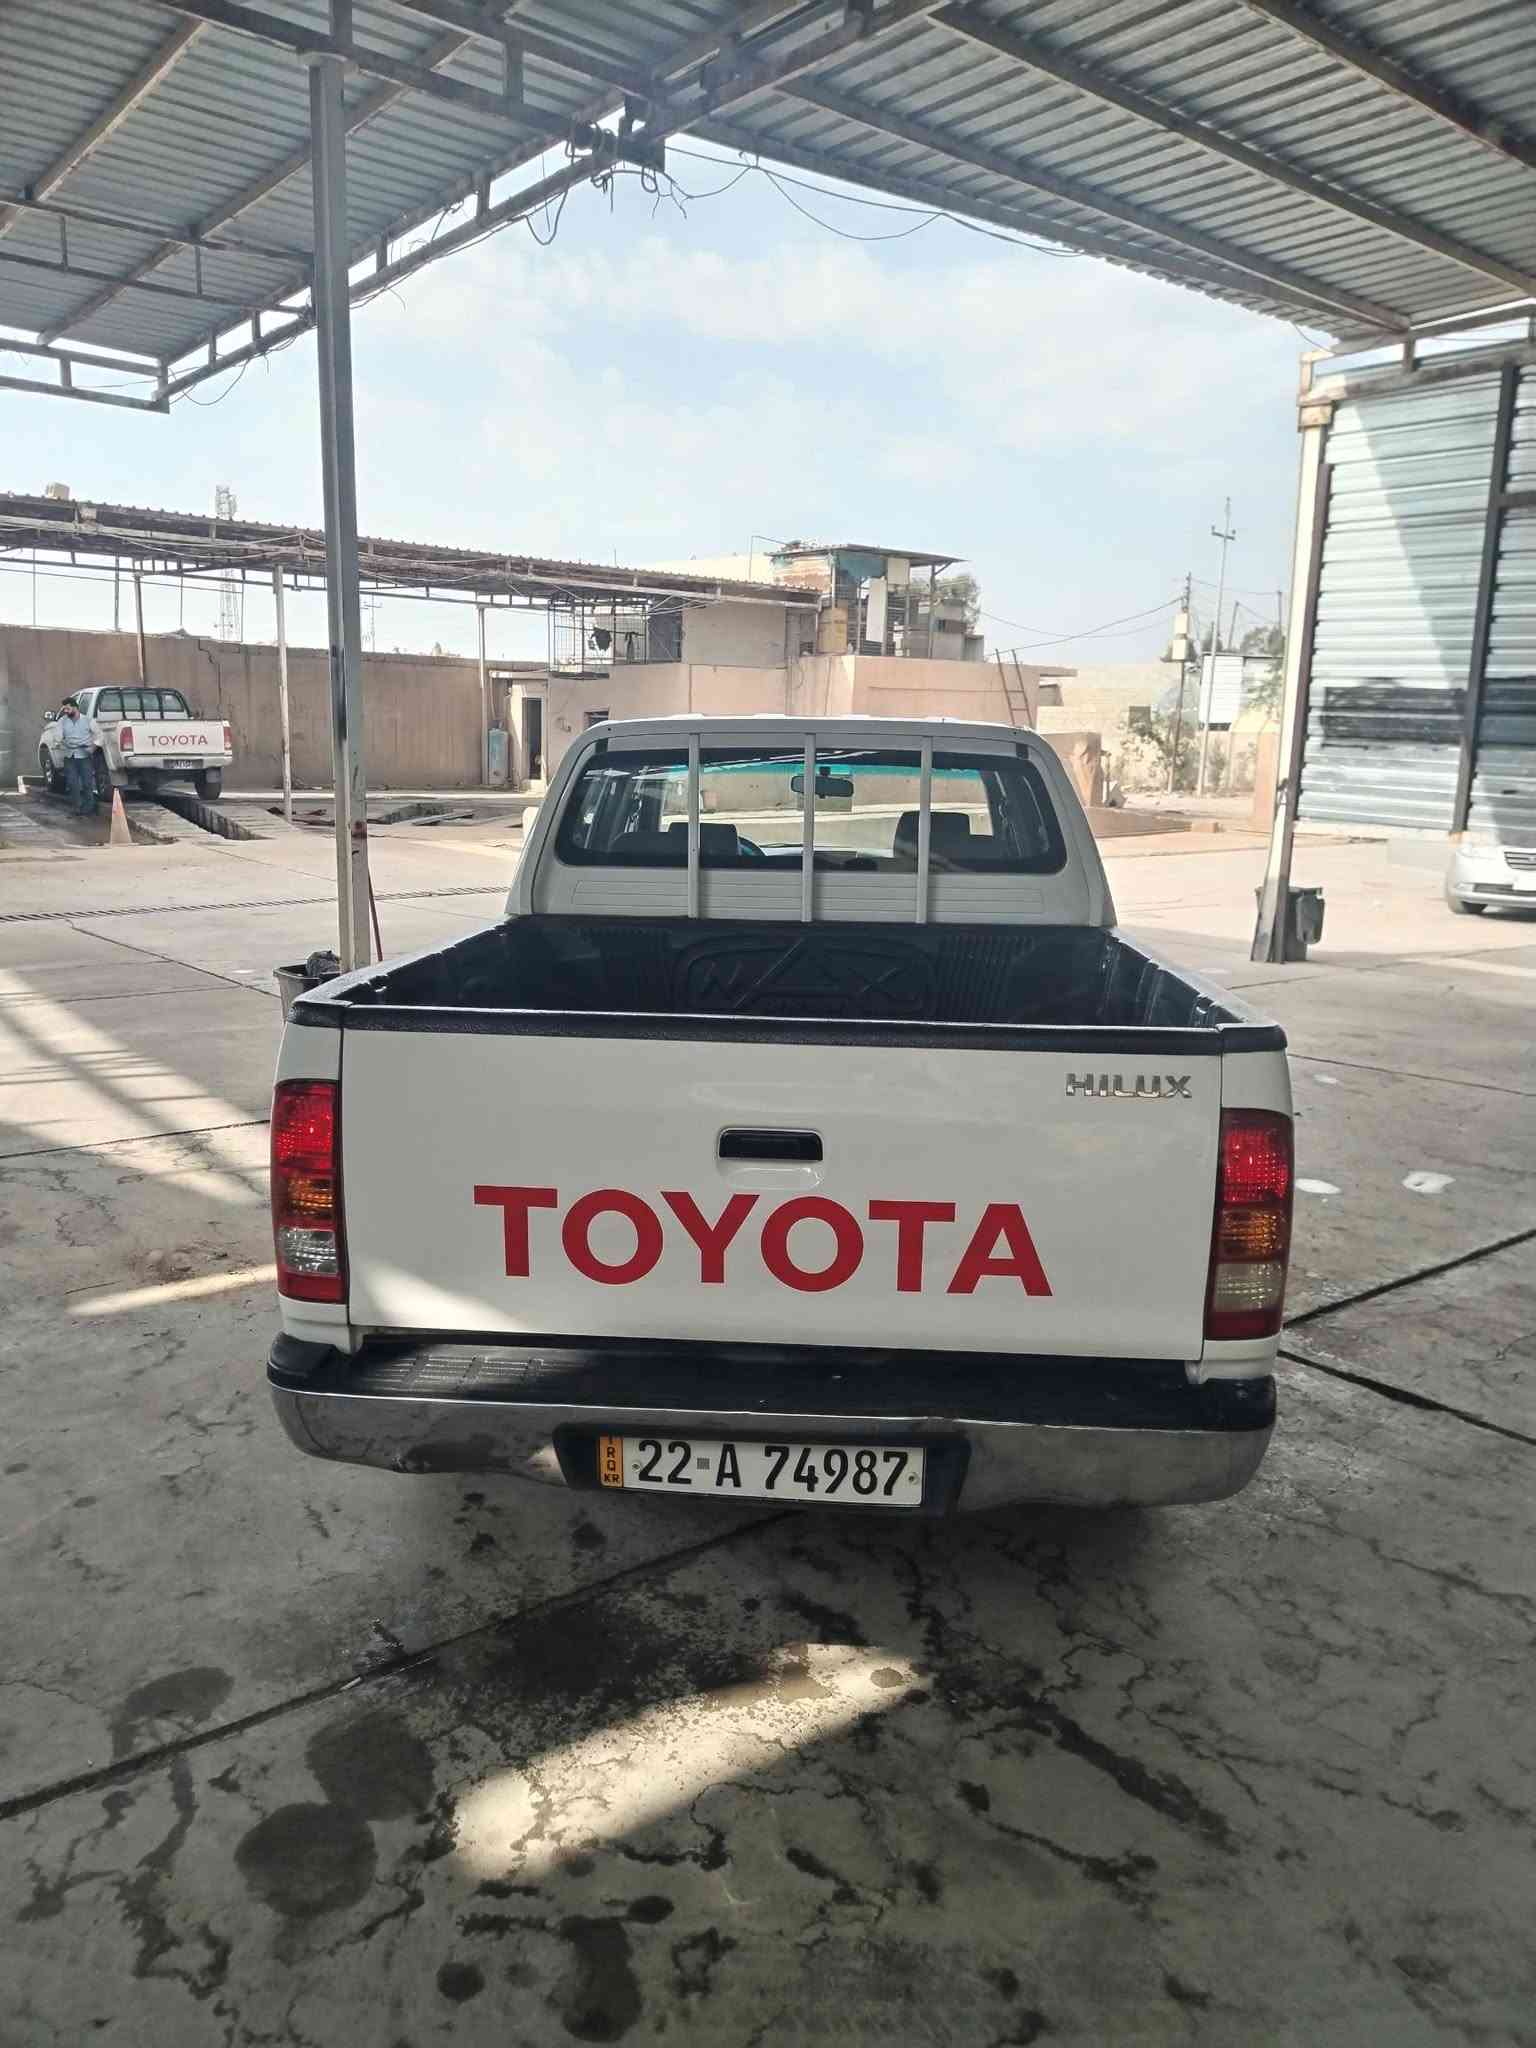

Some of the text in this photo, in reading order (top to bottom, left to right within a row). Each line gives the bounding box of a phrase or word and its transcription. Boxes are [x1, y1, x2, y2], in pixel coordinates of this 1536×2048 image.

[147, 735, 208, 746] TOYOTA
[1066, 1073, 1192, 1098] HILUX
[473, 1184, 1053, 1297] TOYOTA
[764, 1445, 909, 1496] 74987
